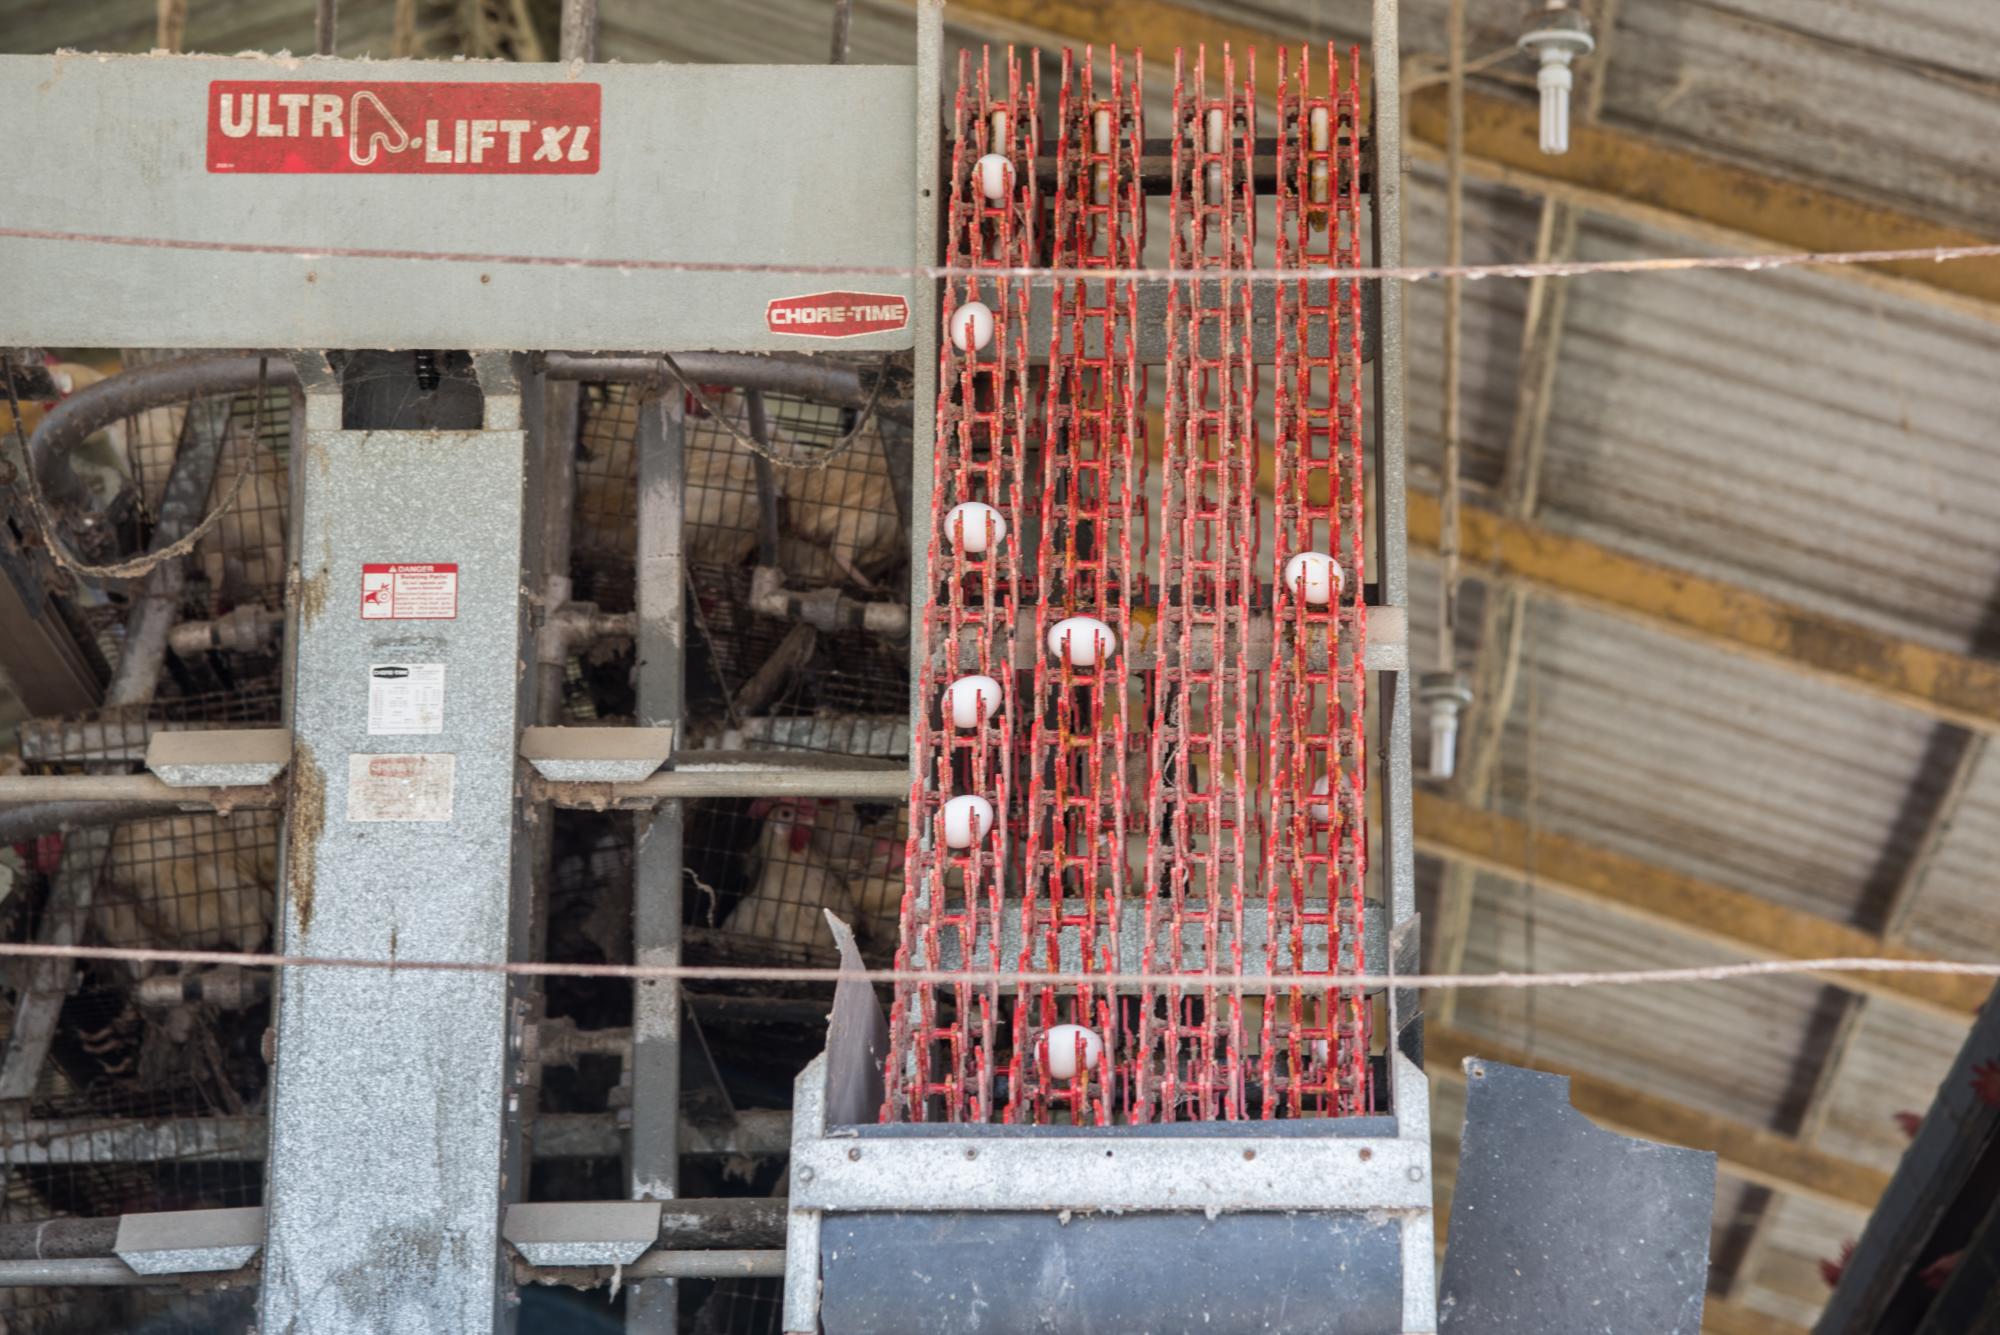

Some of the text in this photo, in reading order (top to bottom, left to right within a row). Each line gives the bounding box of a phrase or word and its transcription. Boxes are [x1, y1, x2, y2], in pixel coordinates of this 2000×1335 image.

[533, 125, 591, 163] XL
[770, 304, 904, 324] CHORE-TIME
[398, 565, 434, 573] DANGER
